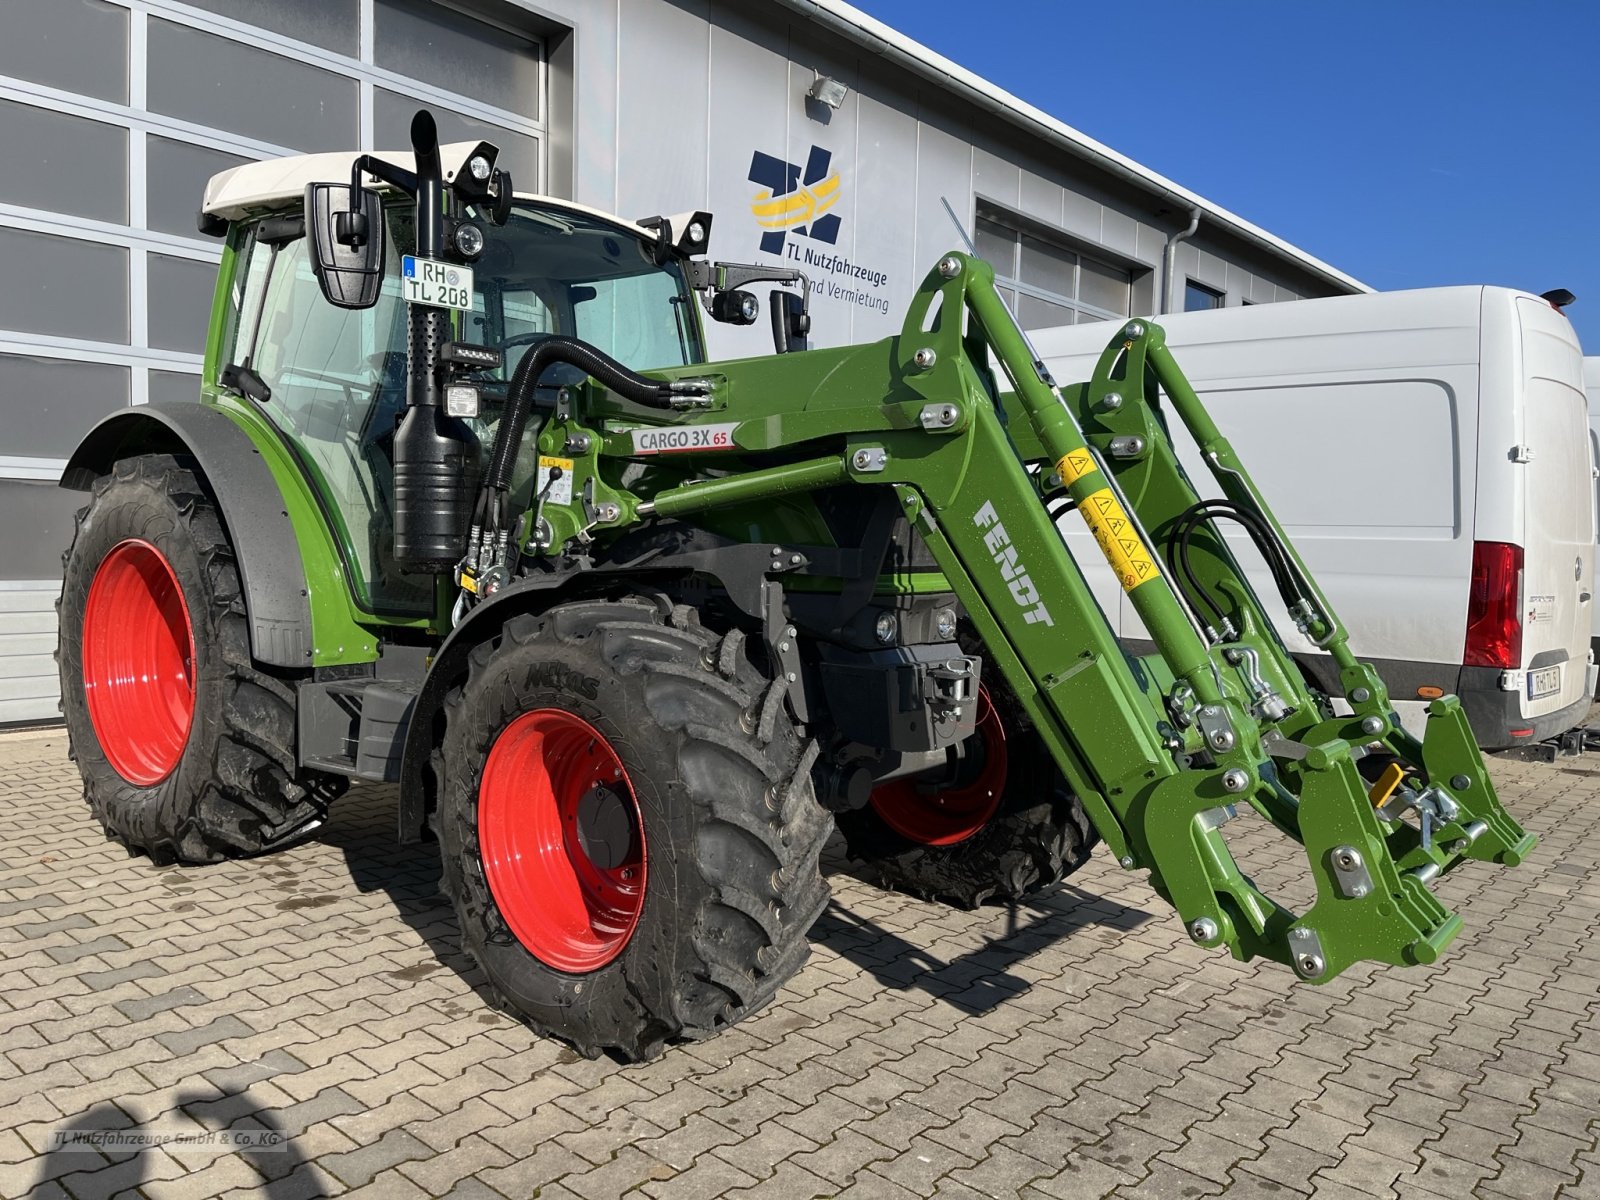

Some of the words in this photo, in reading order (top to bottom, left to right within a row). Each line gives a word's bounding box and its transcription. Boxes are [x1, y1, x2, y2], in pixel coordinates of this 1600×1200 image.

[423, 263, 445, 284] RH
[788, 242, 801, 261] TL
[804, 248, 887, 287] Nutzfahrzeuge
[410, 280, 431, 301] TL
[438, 286, 468, 307] 208
[828, 280, 889, 314] Vermietung
[640, 431, 688, 449] CARGO
[692, 429, 710, 446] 3X
[713, 432, 727, 445] 65
[972, 499, 1055, 627] FENDT
